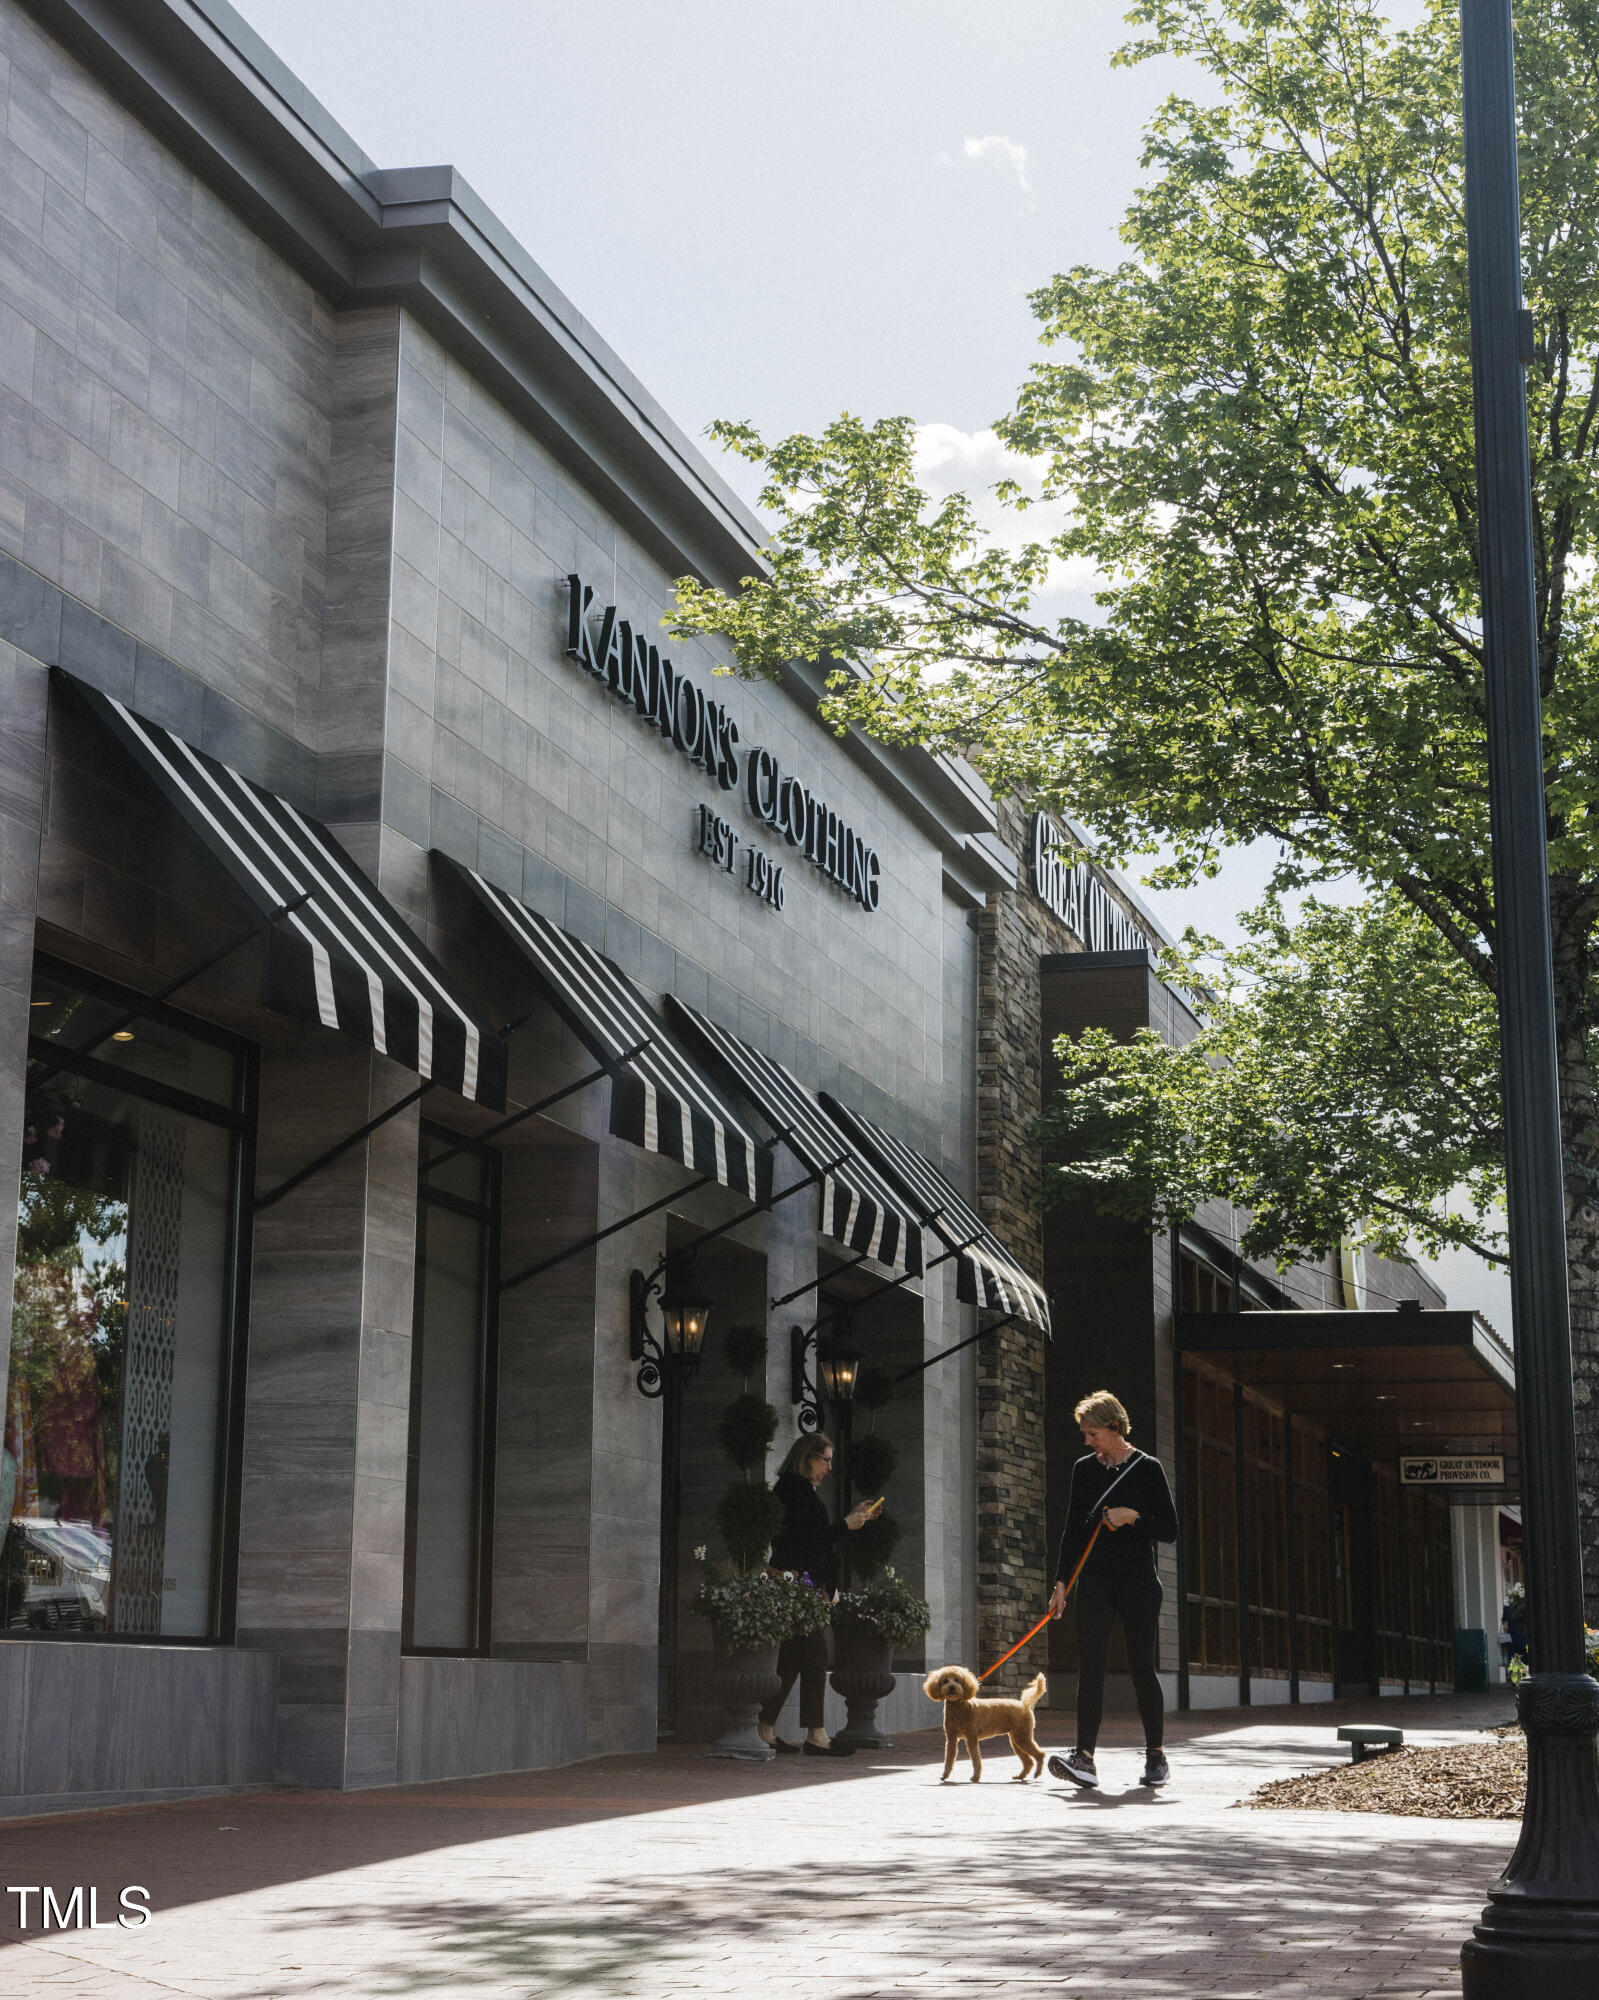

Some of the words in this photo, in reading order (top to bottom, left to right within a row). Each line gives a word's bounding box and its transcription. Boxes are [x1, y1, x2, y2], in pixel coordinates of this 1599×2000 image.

[566, 573, 739, 790] KANNON'S
[748, 746, 880, 912] CLOTHING
[698, 803, 739, 874] EST
[747, 846, 785, 912] 1916
[1033, 810, 1087, 944] GREAT
[1440, 1460, 1462, 1469] GREAT
[1464, 1460, 1500, 1470] OUTDOOR
[1440, 1471, 1478, 1480] PROVISION
[1480, 1471, 1491, 1480] CO.
